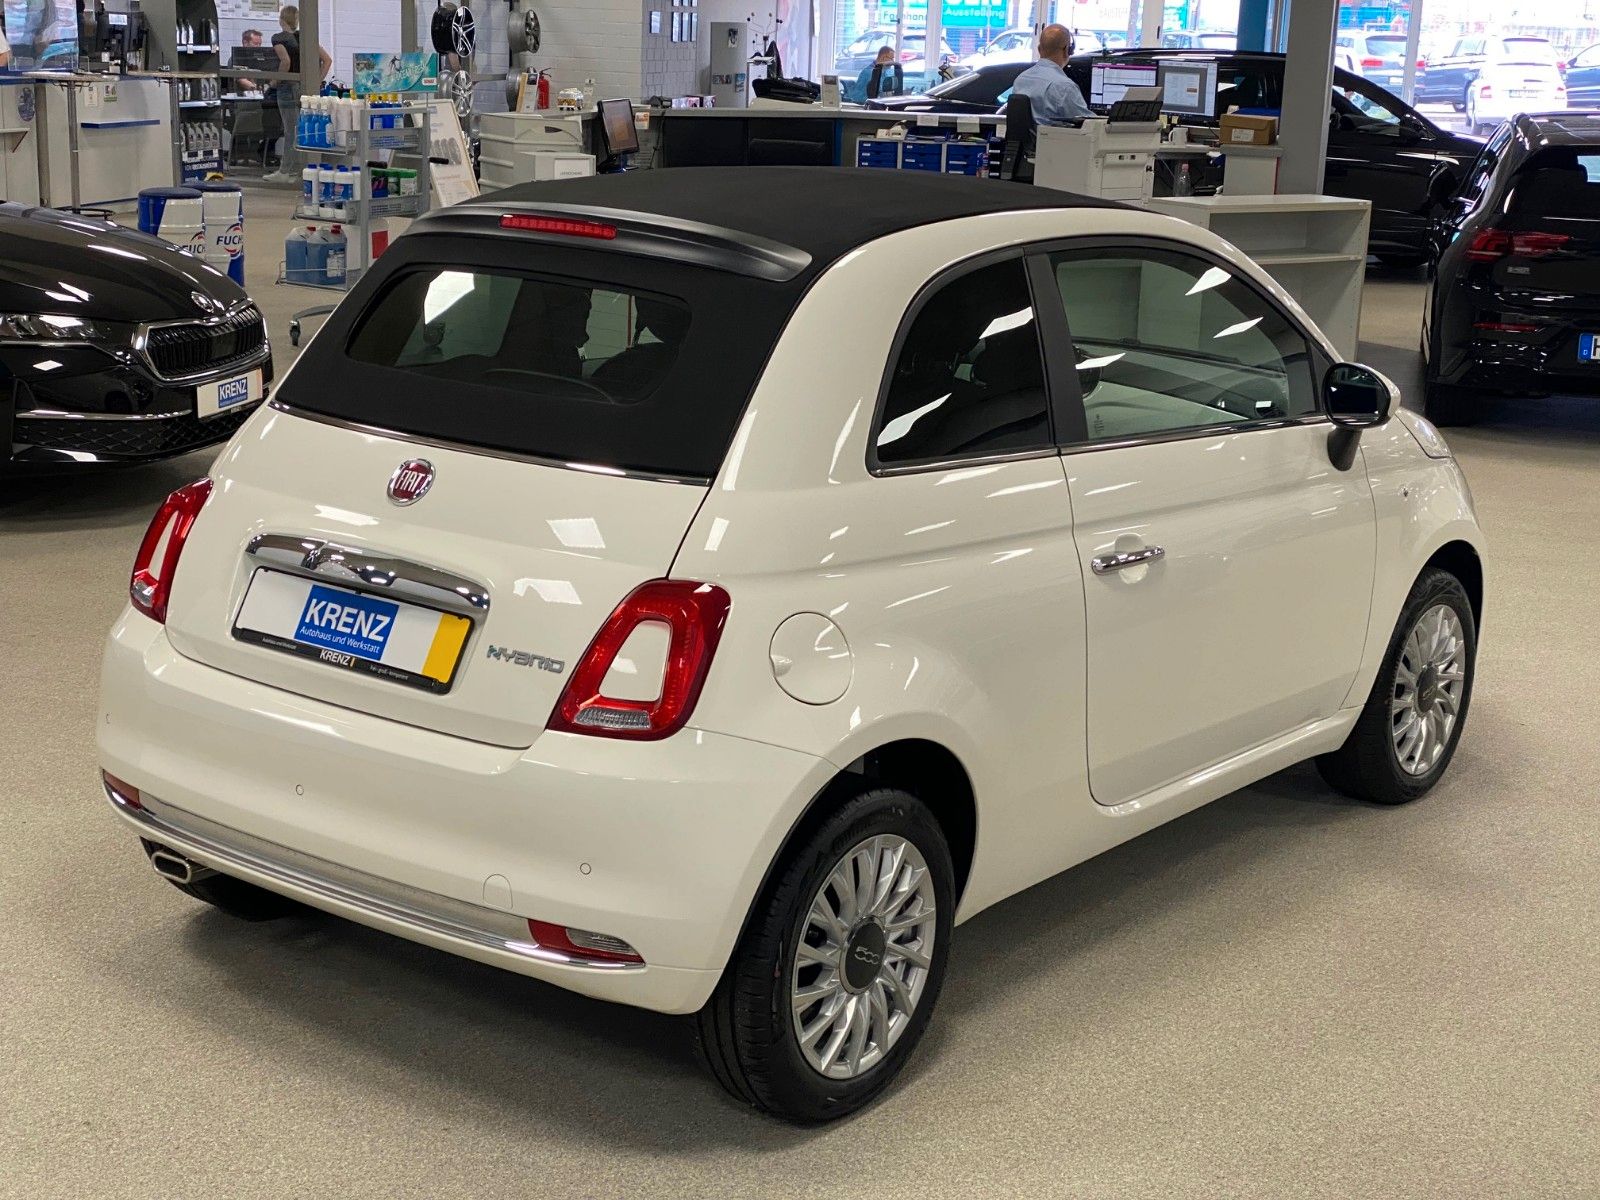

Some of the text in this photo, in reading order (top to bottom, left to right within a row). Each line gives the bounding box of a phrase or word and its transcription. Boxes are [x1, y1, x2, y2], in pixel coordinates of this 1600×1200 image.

[944, 7, 1005, 19] Ausstellng
[219, 380, 247, 400] KRENZ
[395, 469, 426, 493] FIAT
[304, 598, 391, 643] KRENZ
[299, 625, 381, 654] Autohaus und Werkstatt
[319, 648, 351, 666] KRENZ
[486, 644, 566, 674] HYBRID
